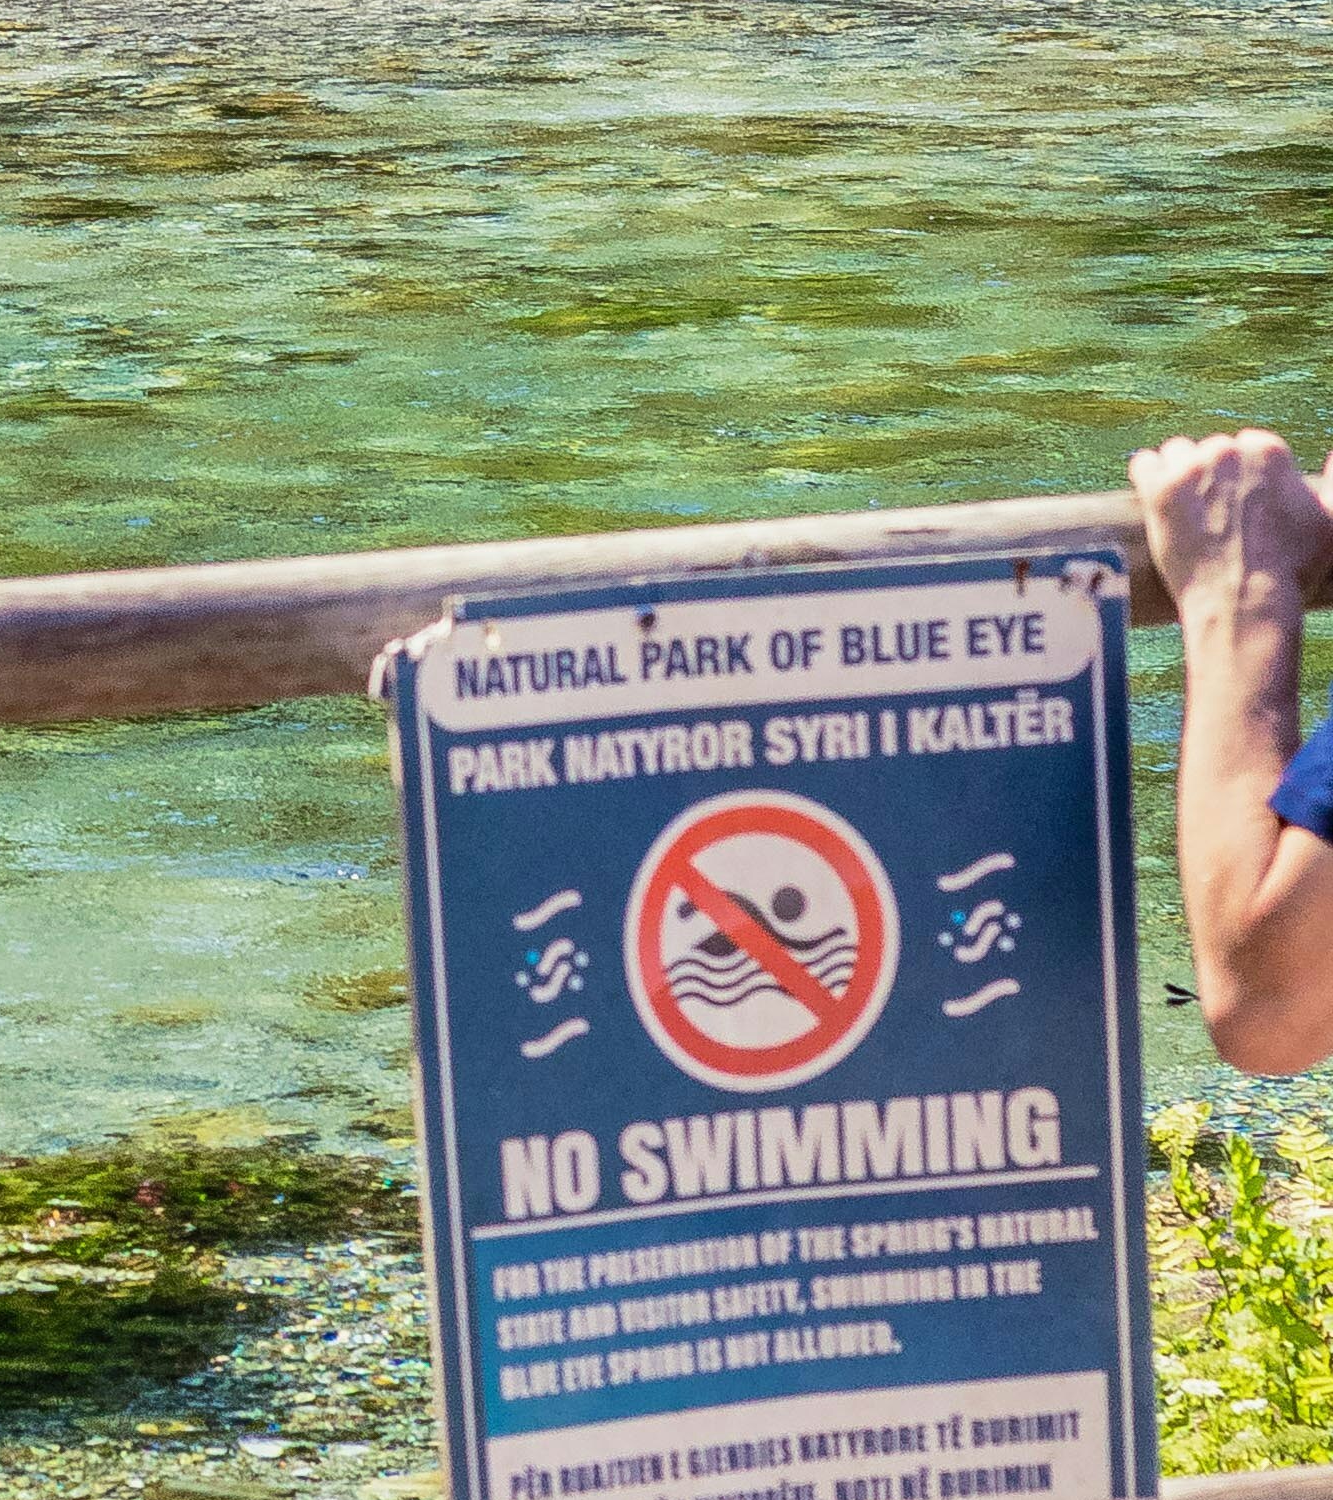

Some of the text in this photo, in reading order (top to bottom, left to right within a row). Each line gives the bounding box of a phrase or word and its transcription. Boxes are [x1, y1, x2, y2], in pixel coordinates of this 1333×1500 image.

[455, 611, 1047, 701] NATURAL PARK OF BLUE EYE
[449, 690, 1076, 796] PARK NATYROR SYRI I KALTËR
[501, 1087, 1062, 1220] NO SWIMMING
[542, 1257, 586, 1294] THE
[759, 1229, 793, 1266] OF
[797, 1225, 847, 1263] THE
[978, 1206, 1099, 1248] NATURAL
[991, 1260, 1042, 1295] THE
[697, 1338, 723, 1373] IS
[725, 1332, 770, 1370] NOT
[937, 1415, 963, 1449] TË
